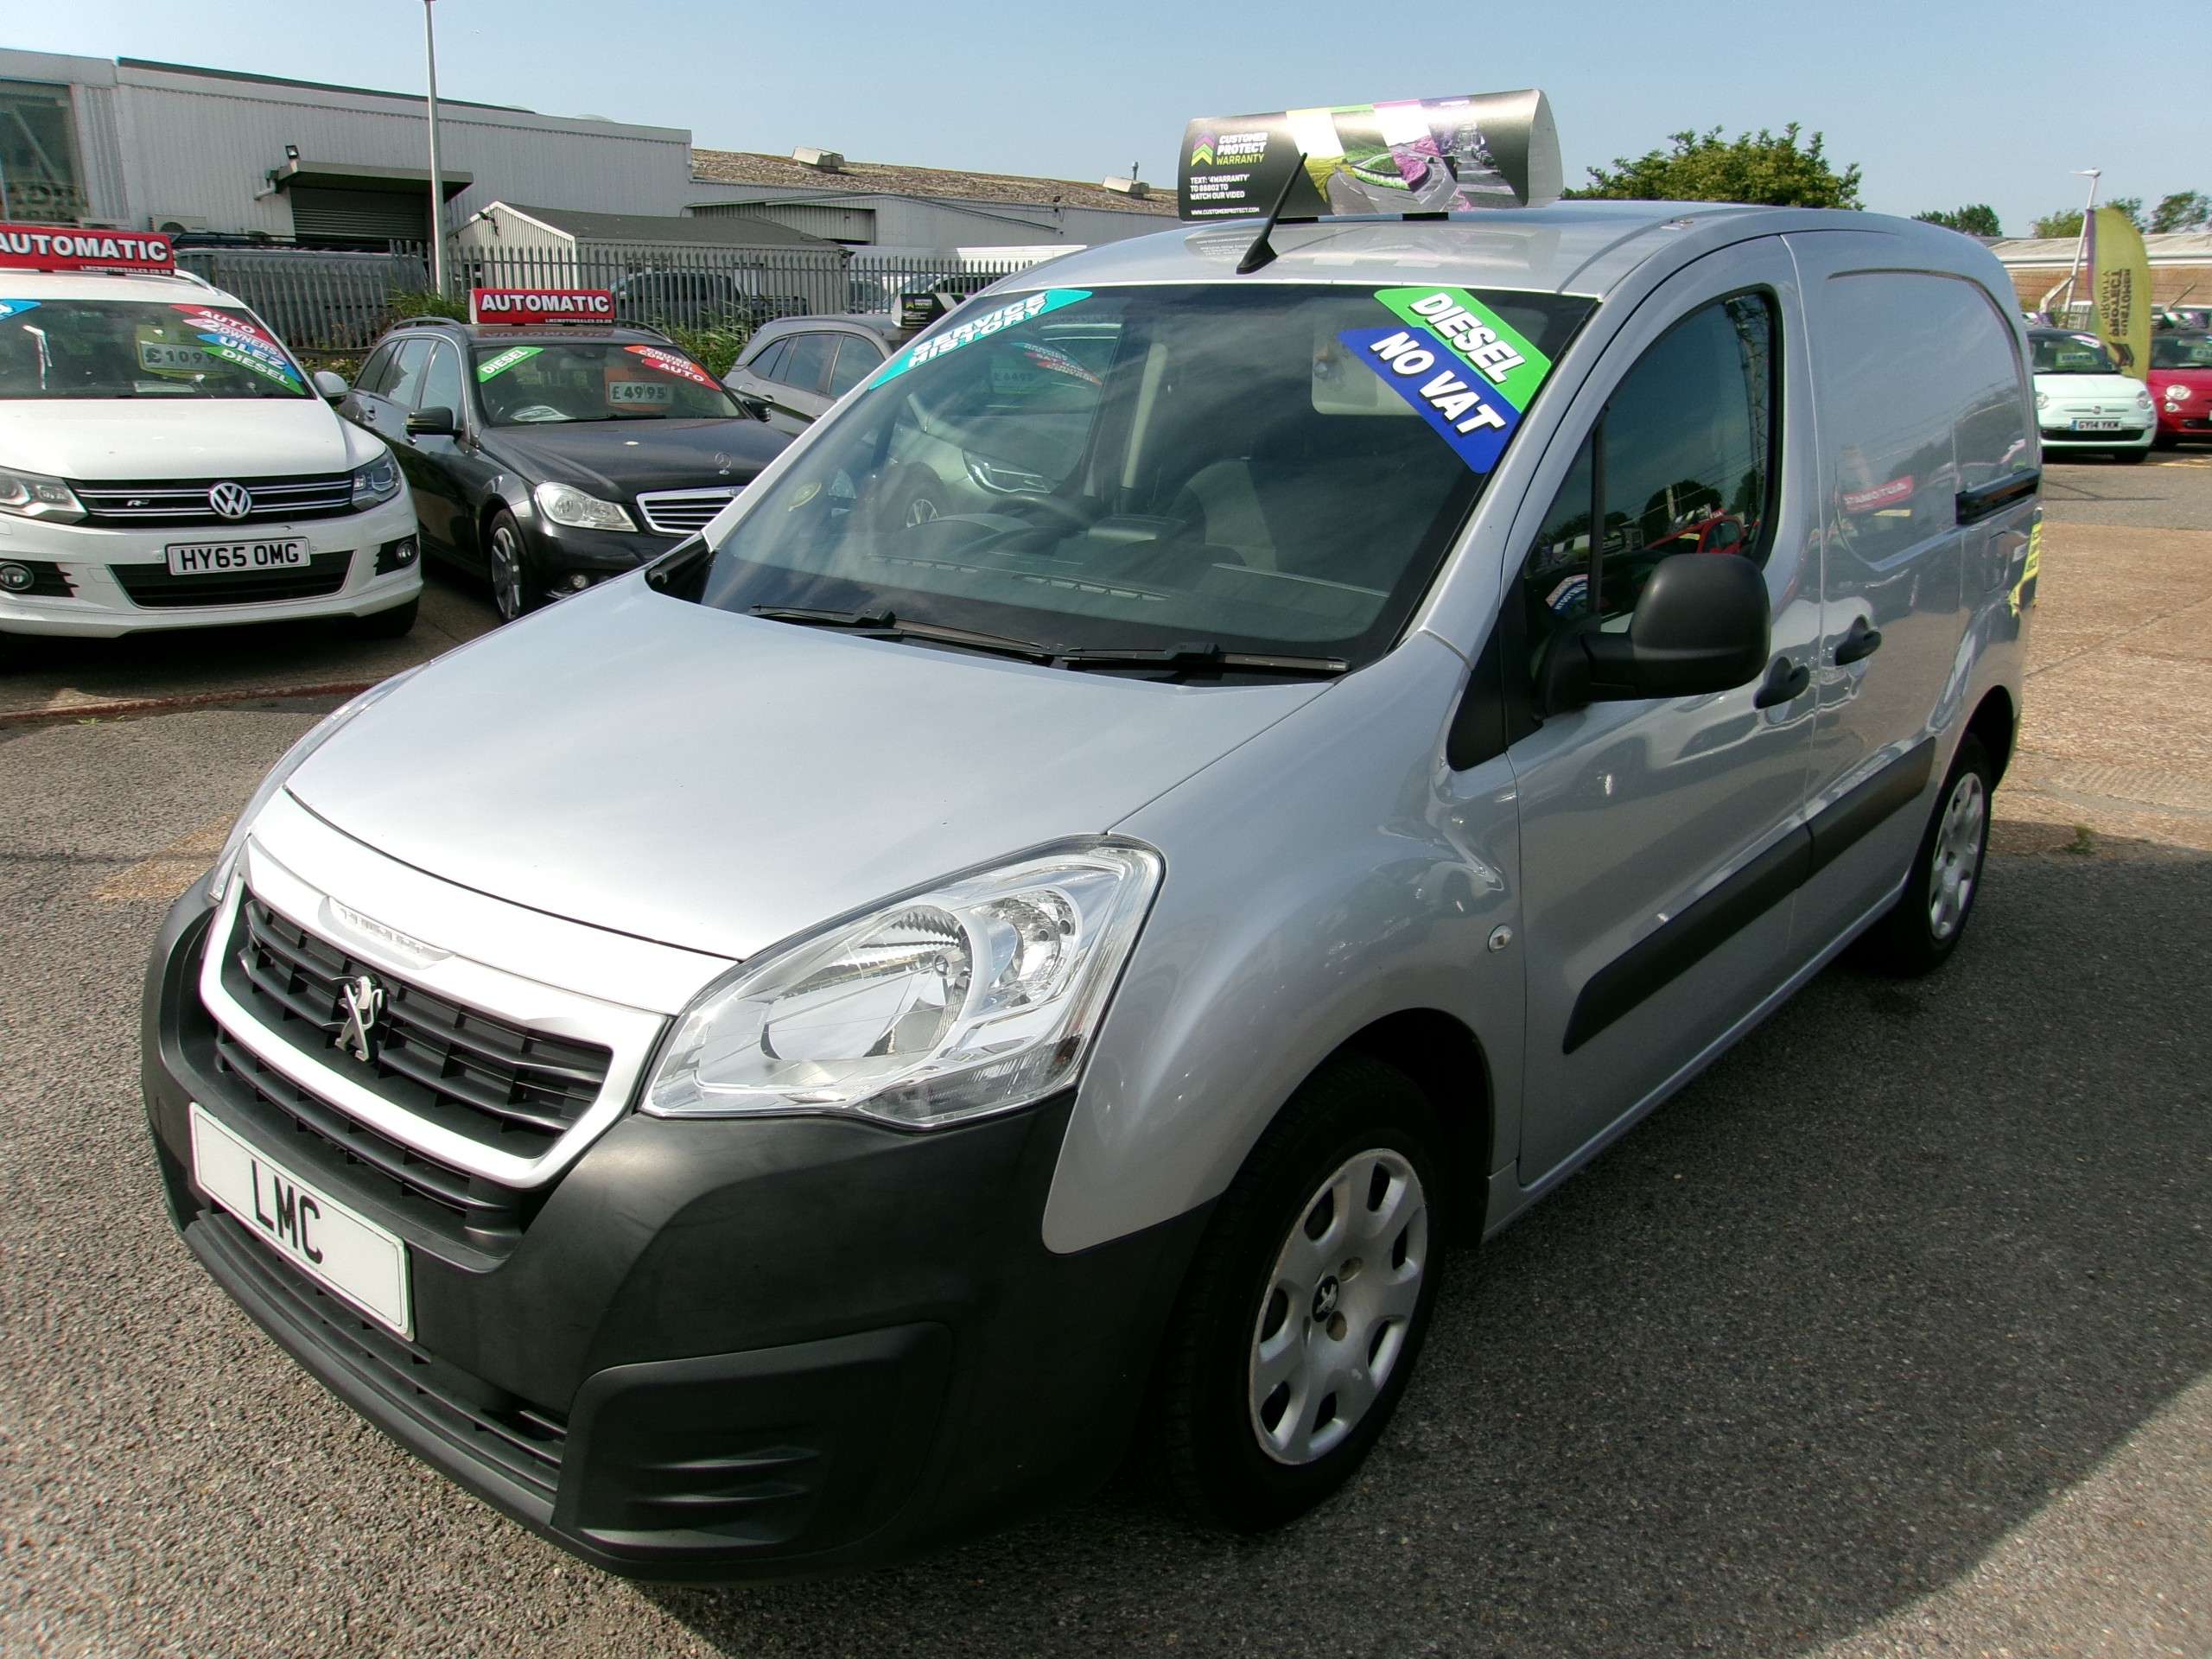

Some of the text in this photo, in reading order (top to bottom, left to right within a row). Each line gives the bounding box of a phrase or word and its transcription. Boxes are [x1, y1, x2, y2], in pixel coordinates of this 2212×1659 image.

[1217, 142, 1267, 156] PROTECT
[1218, 132, 1268, 144] CUSTOMER
[1216, 154, 1264, 165] WARRANTY
[0, 232, 168, 261] AUTOMATIC
[480, 294, 610, 313] AUTOMATIC
[198, 310, 256, 334] AUTO
[200, 318, 279, 355] 2 OWNERS
[907, 304, 1046, 369] HISTORY
[912, 293, 1048, 356] SERVICE
[219, 335, 287, 371] ULEZ
[1407, 292, 1527, 385] DIESEL
[220, 348, 289, 385] DIESEL
[480, 349, 529, 374] DIESEL
[658, 363, 705, 382] AUTO
[1369, 331, 1507, 435] NO VAT
[180, 543, 300, 571] HY65 OMG
[251, 1158, 324, 1265] LMC
